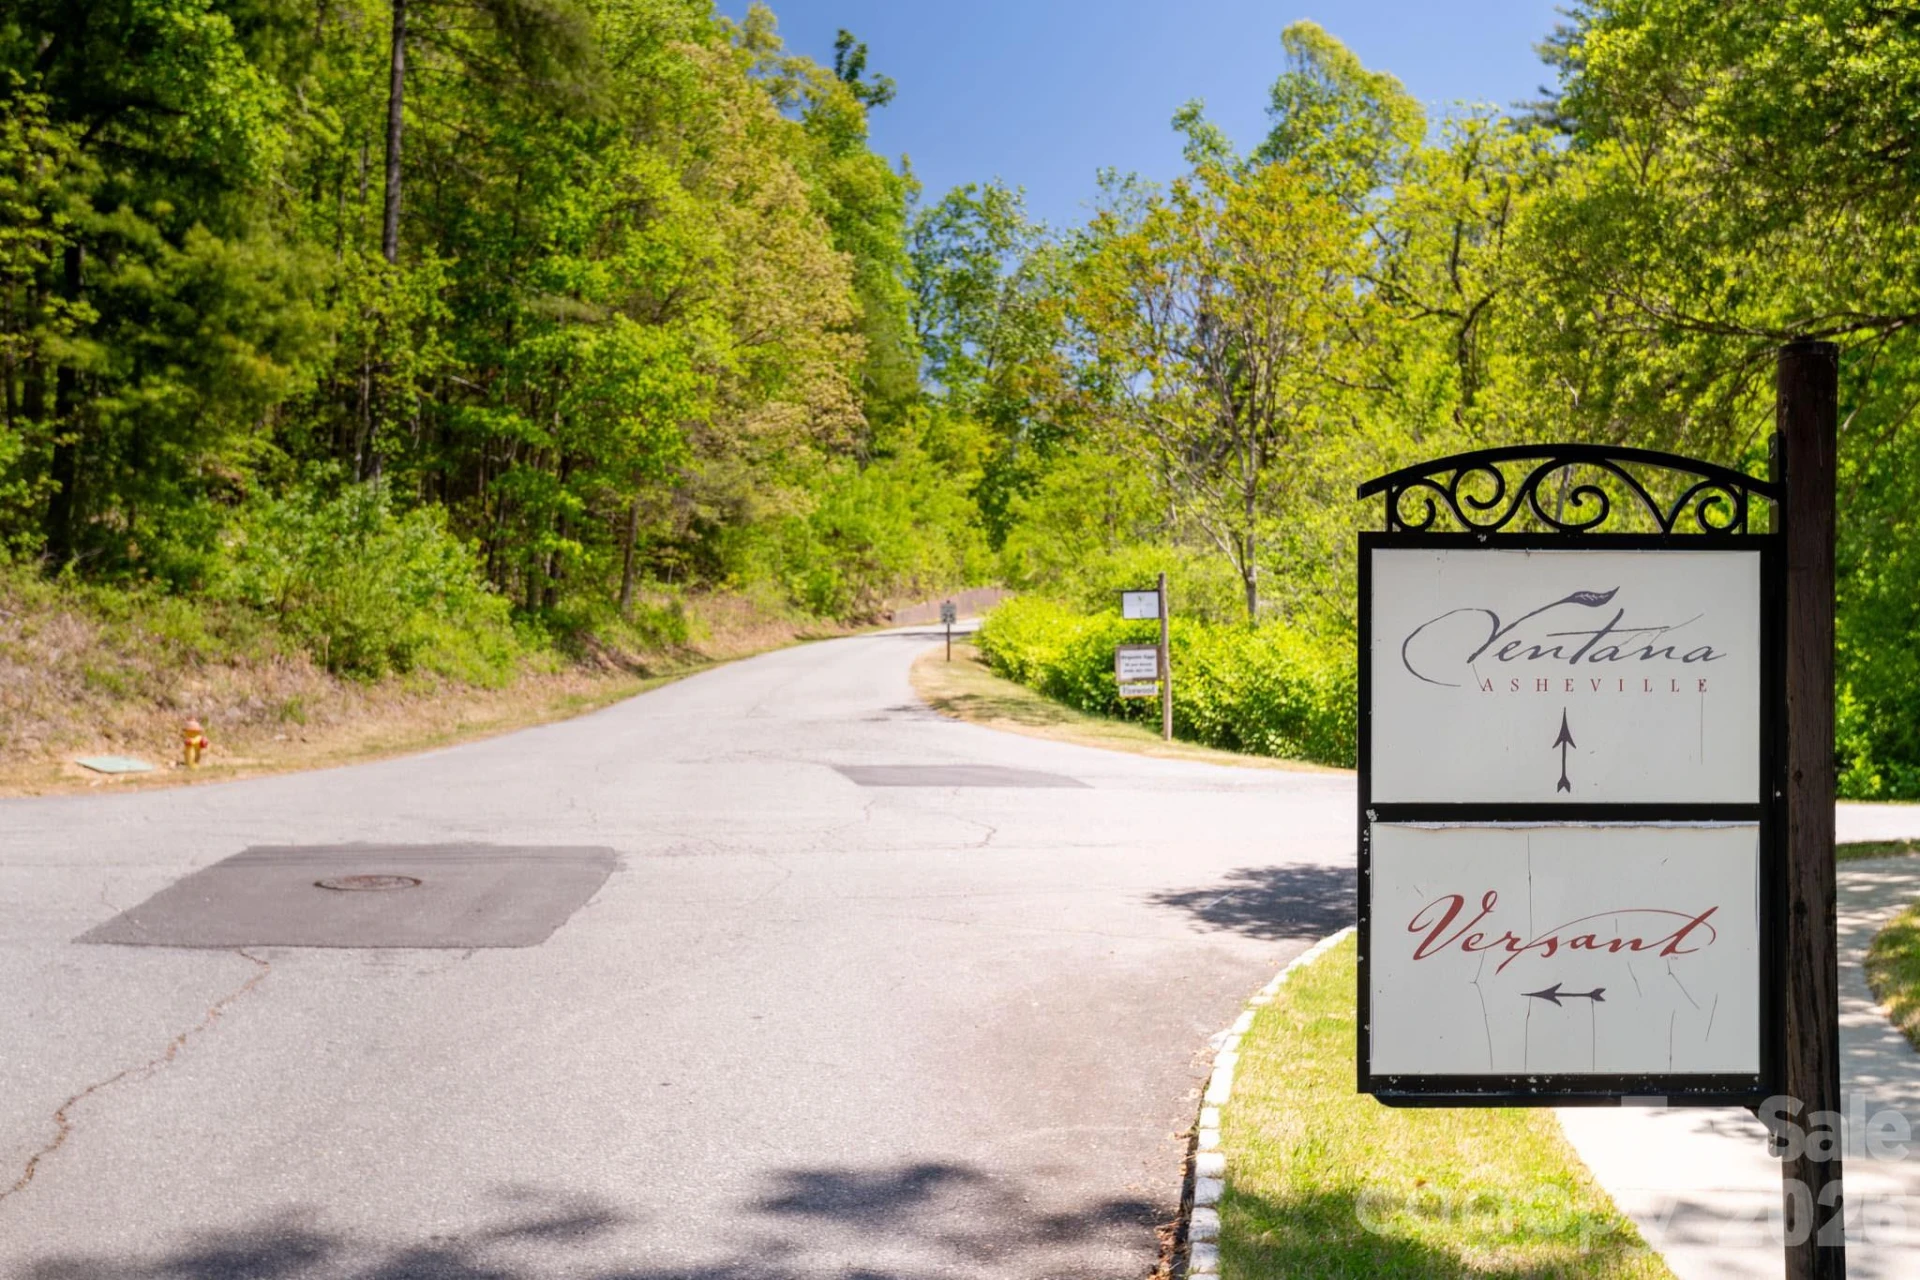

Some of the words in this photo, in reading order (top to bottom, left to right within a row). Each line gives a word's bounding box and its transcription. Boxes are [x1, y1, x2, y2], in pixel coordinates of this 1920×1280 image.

[1402, 586, 1727, 687] Ventana
[1481, 677, 1708, 693] ASHEVILLE
[1407, 890, 1719, 975] Versant
